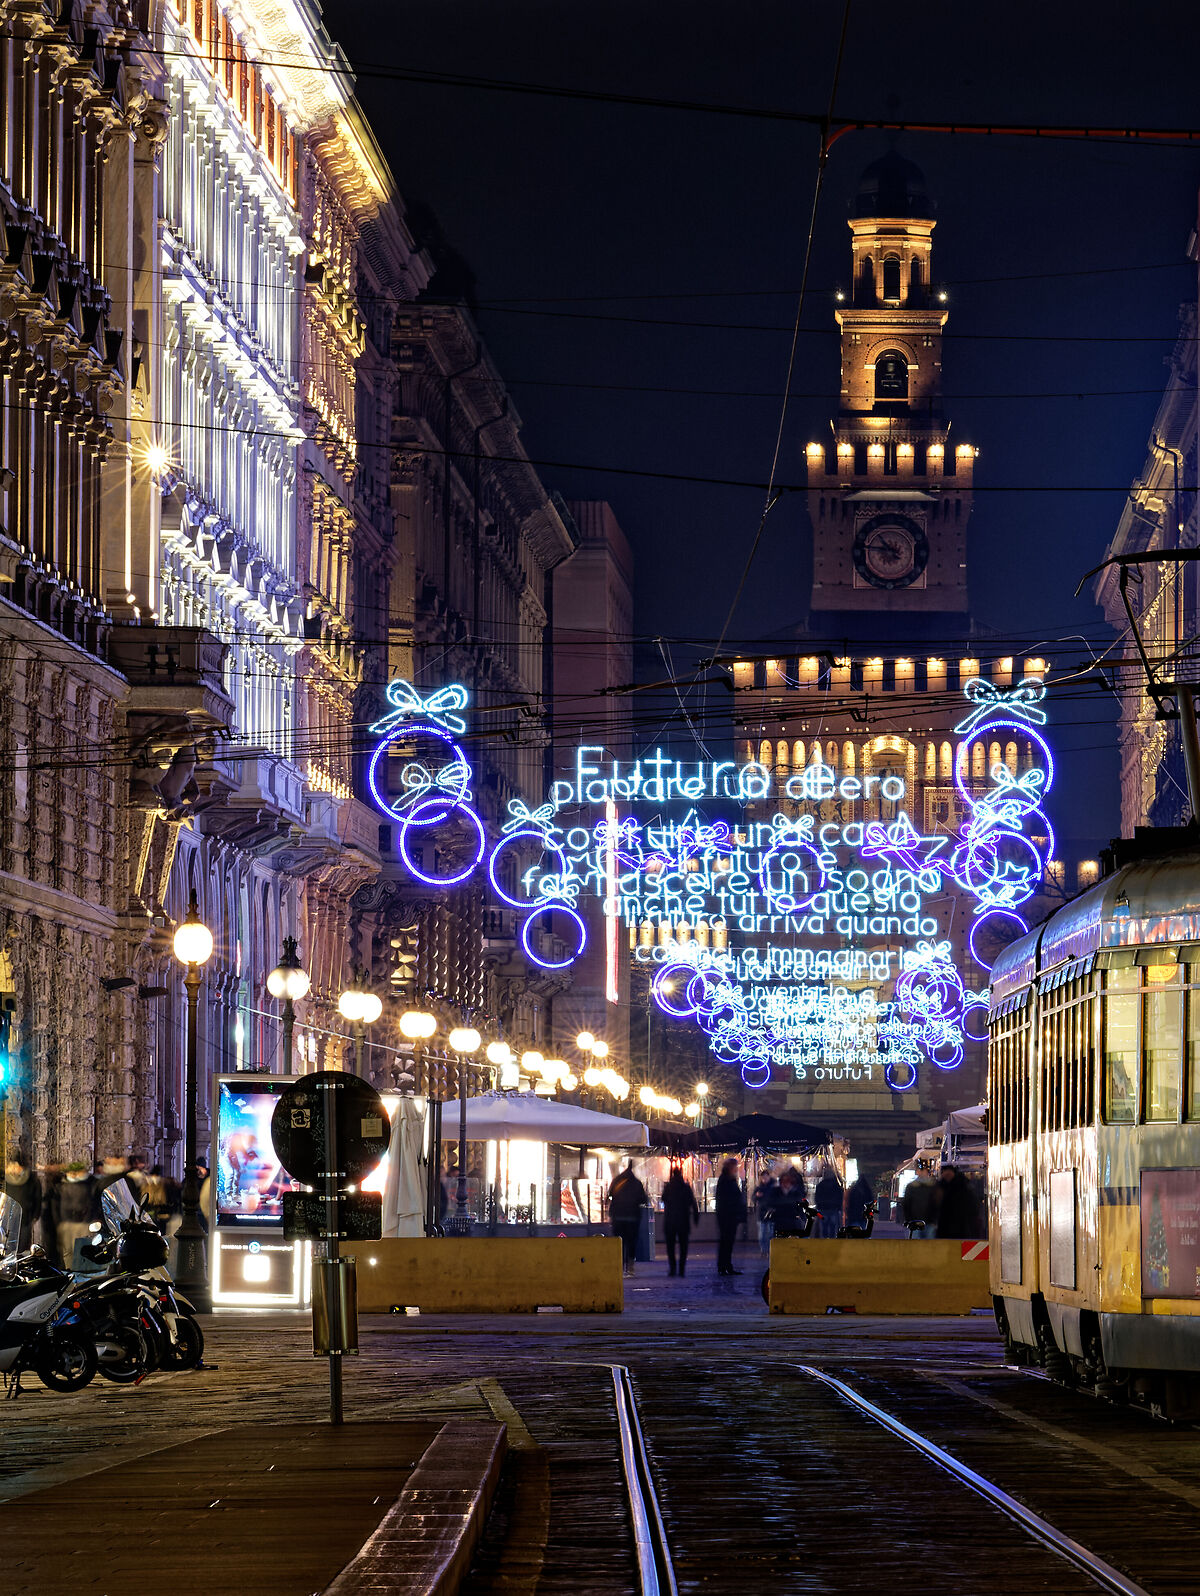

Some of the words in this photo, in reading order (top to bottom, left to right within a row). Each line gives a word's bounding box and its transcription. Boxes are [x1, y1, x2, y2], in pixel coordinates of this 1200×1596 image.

[553, 770, 706, 812] pantare
[577, 746, 771, 803] Futuro
[544, 818, 716, 851] coruire
[702, 845, 801, 875] futuro
[768, 870, 809, 895] un
[827, 868, 942, 902] sogno
[716, 886, 796, 915] tutto
[811, 888, 921, 920] questo
[738, 914, 824, 935] arriva
[836, 912, 938, 940] quando
[766, 941, 918, 974] immaginarl
